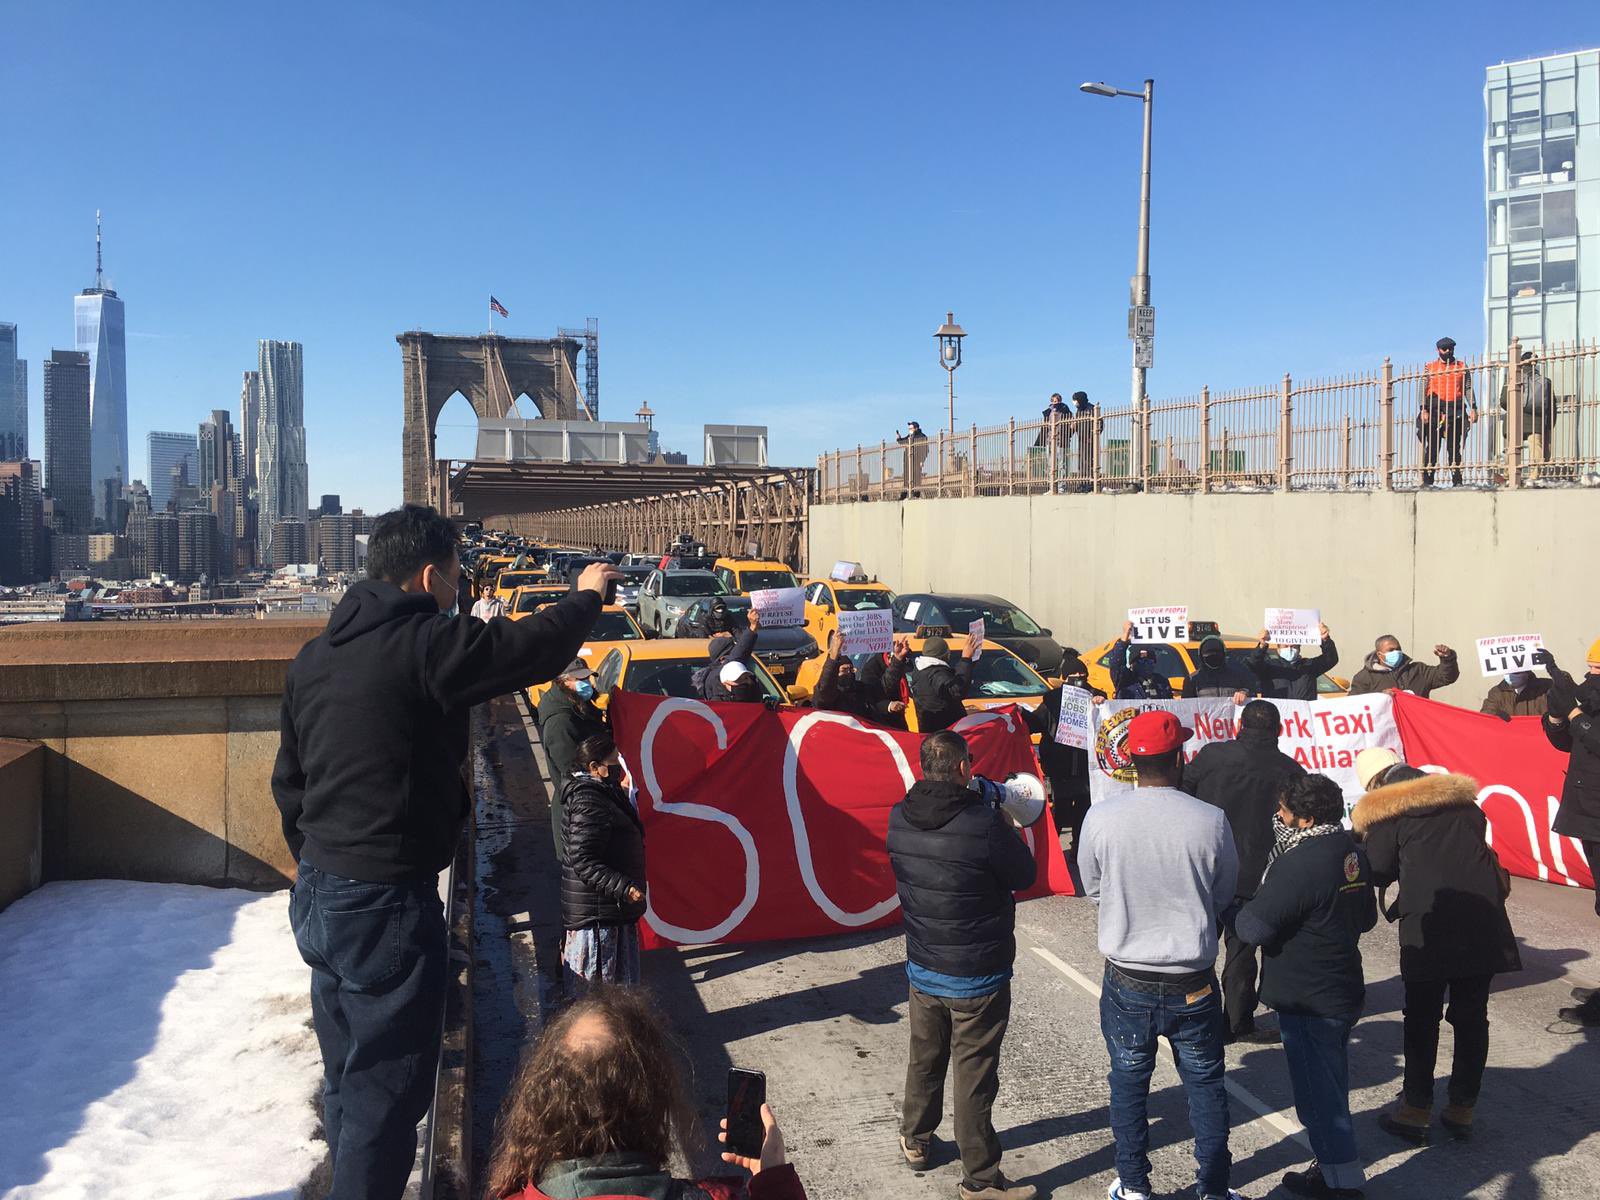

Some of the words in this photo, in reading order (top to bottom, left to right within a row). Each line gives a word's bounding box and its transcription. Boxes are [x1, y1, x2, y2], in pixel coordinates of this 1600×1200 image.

[865, 619, 892, 627] HOMES
[1140, 617, 1156, 625] LET
[1158, 616, 1171, 624] US
[867, 626, 889, 635] LIVES
[1133, 626, 1185, 640] LIVE
[1497, 636, 1516, 644] YOUR
[868, 641, 891, 651] NOW!
[1490, 646, 1508, 656] LET
[1511, 644, 1526, 653] US
[1485, 652, 1545, 672] LIVE
[1061, 710, 1078, 718] SAVE
[1060, 715, 1088, 730] HOMES
[1194, 712, 1243, 741] New
[1315, 705, 1375, 738] Taxi
